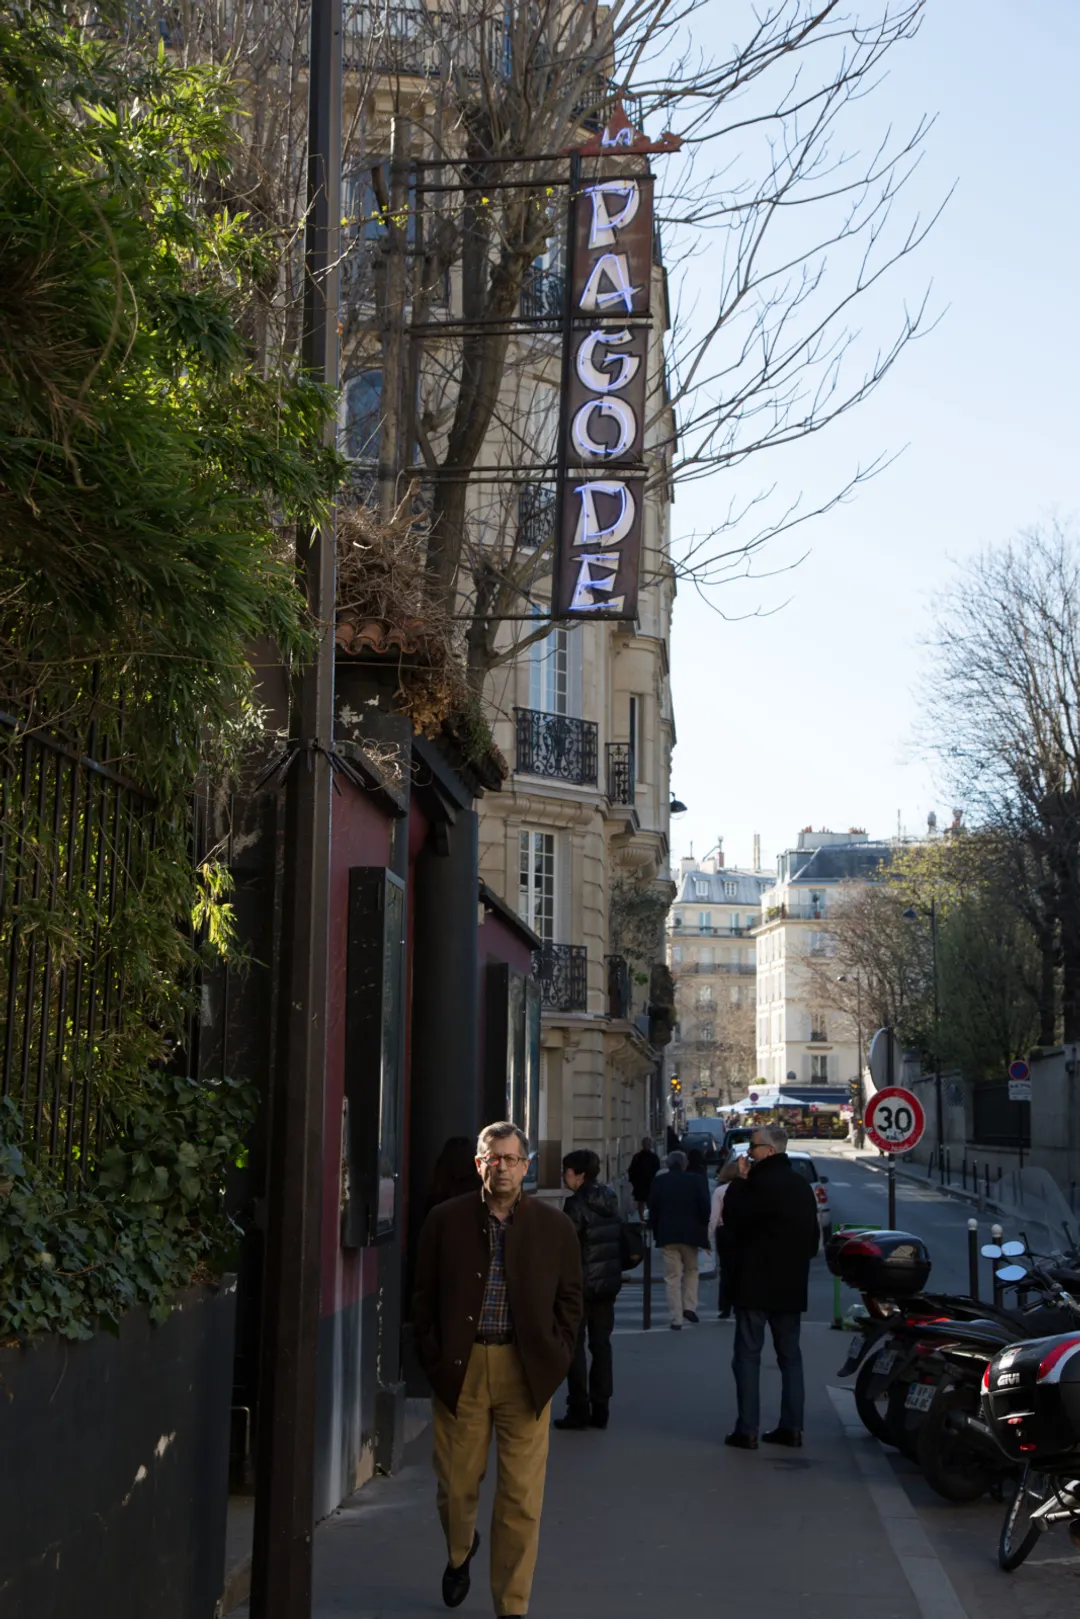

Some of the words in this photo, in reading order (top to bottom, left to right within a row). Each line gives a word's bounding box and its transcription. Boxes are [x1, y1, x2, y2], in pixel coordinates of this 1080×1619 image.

[569, 179, 641, 613] PAGODE
[877, 1106, 913, 1133] 30
[997, 1372, 1021, 1386] GIVI
